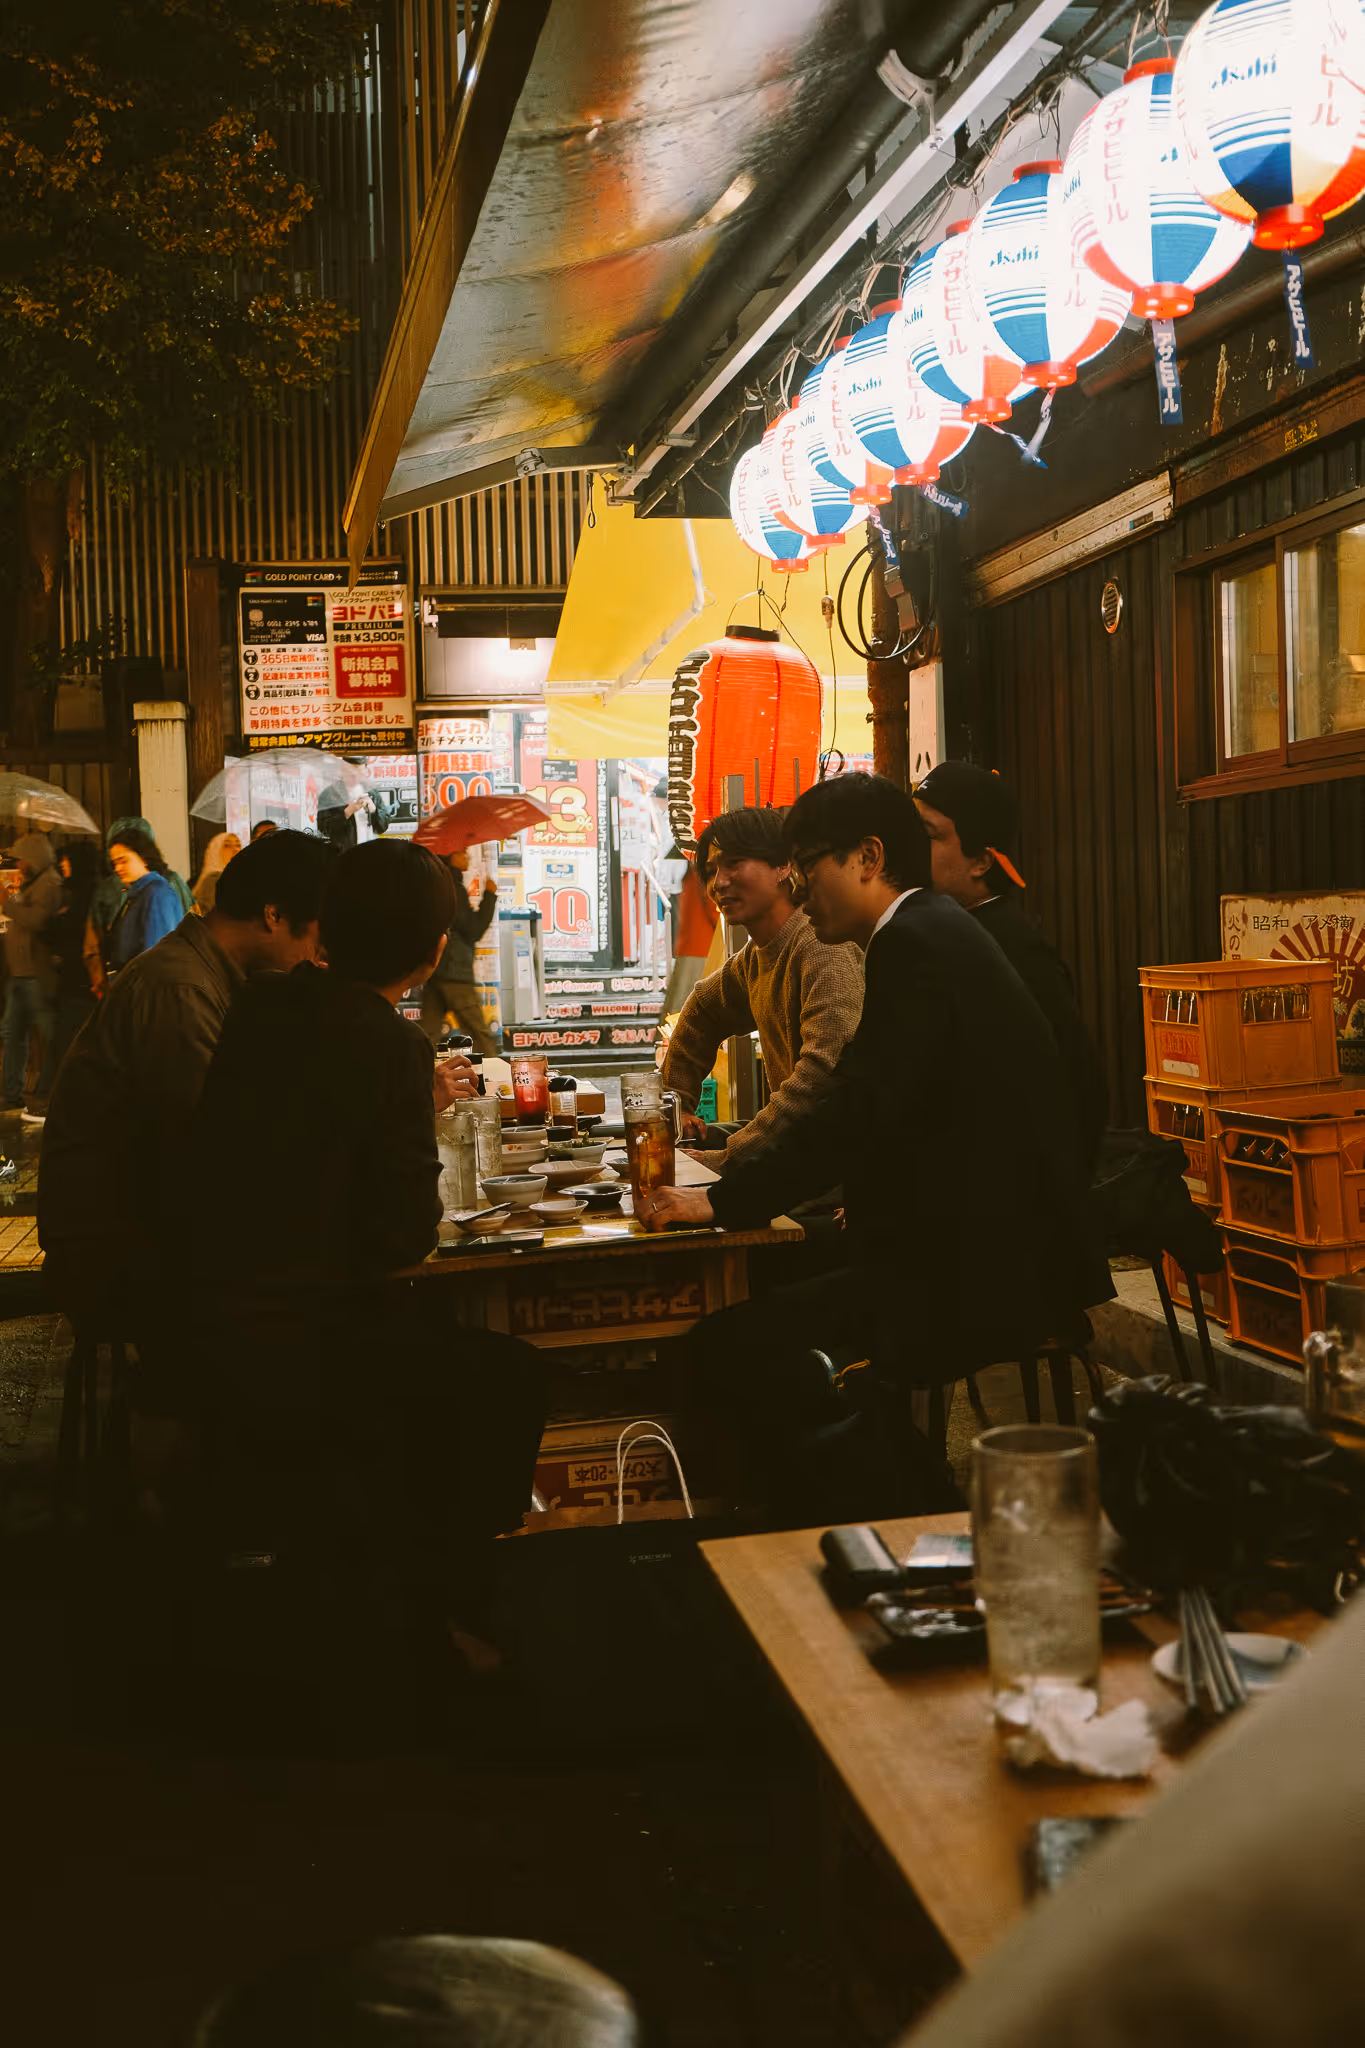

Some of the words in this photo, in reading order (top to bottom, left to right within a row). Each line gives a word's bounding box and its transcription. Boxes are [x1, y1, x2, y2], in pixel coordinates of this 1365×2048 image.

[1210, 53, 1276, 89] Asahi
[1103, 95, 1129, 225] アサヒビール
[990, 245, 1039, 267] Asahi
[944, 250, 968, 357] アサヒビール
[1286, 264, 1310, 358] アサヒビール
[1156, 332, 1179, 414] アサヒビール
[848, 376, 882, 396] Asahi
[781, 424, 802, 507] アサヒビール
[313, 573, 335, 581] CARD
[332, 604, 404, 621] ヨドバシ
[344, 622, 392, 630] PREMIUM
[341, 656, 399, 672] 新規会員
[348, 672, 391, 688] 募集中
[250, 702, 383, 716] この他にもプレミアム会員様
[250, 715, 404, 729] 専用特典を数多くご用意しました
[420, 736, 490, 746] マルチメディア
[1252, 914, 1289, 931] 昭和
[1303, 914, 1352, 931] アメ横
[562, 980, 604, 992] Camera
[611, 977, 667, 991] いらっしゃ
[513, 1031, 600, 1047] ヨドバシカメラ
[512, 1282, 702, 1330] アサヒビール
